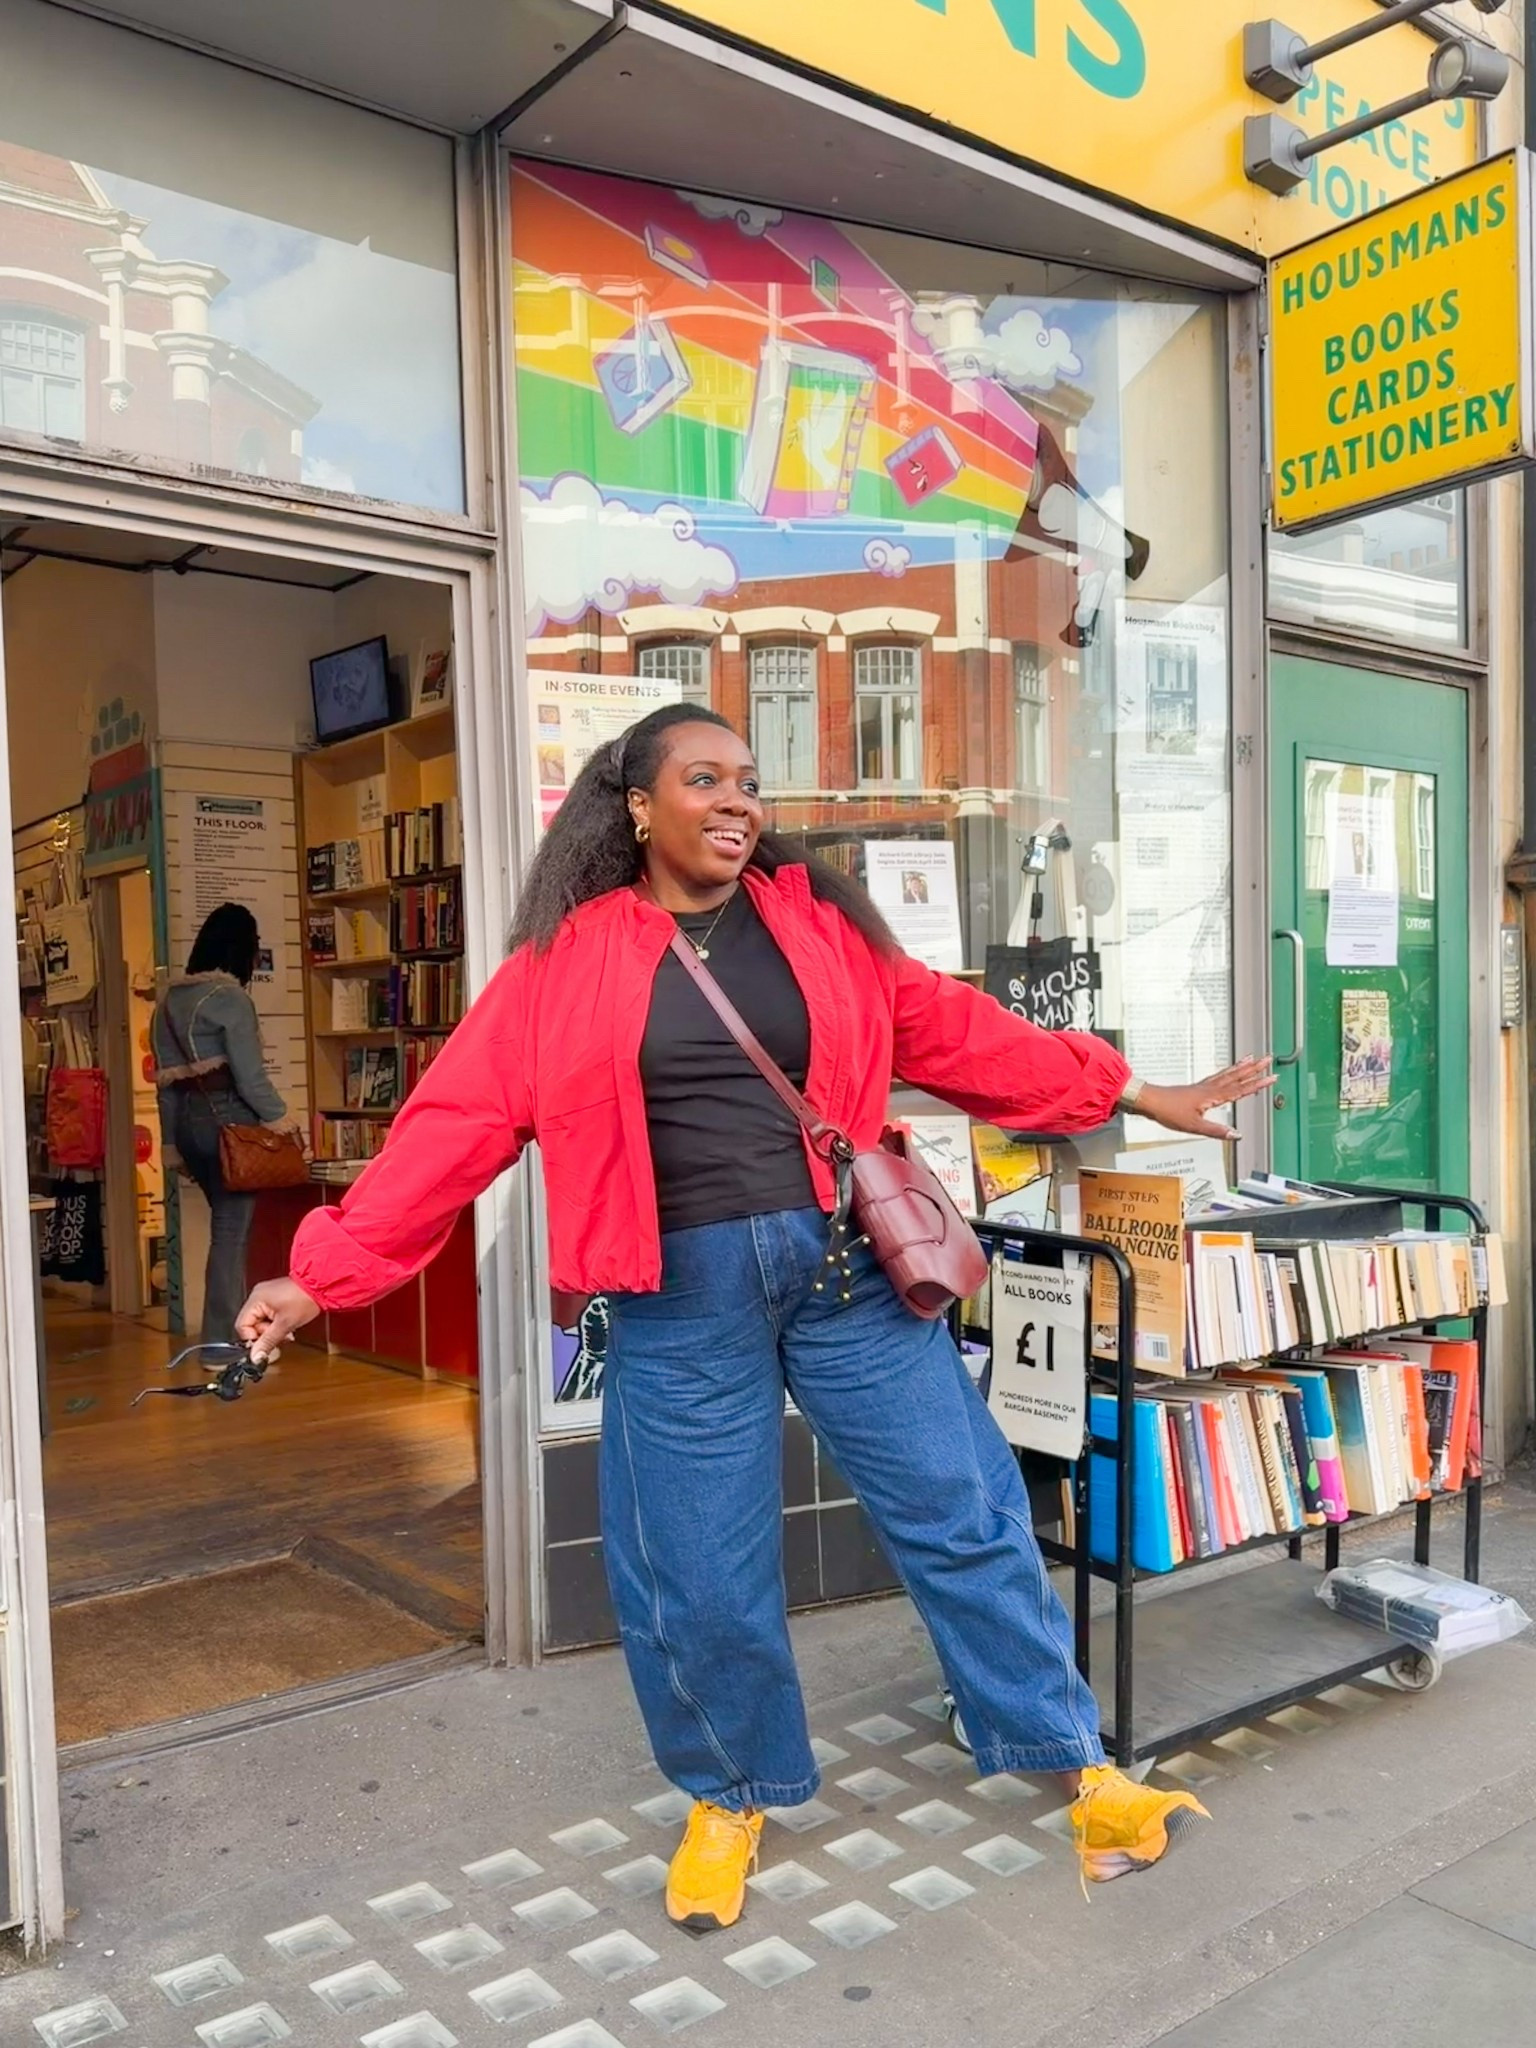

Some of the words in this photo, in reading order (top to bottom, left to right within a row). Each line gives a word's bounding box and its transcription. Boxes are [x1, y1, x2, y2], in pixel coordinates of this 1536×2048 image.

[1297, 73, 1431, 183] PEACE
[1282, 184, 1507, 315] HOUSMANS
[1324, 289, 1461, 375] BOOKS
[1327, 348, 1456, 426] CARDS
[1280, 382, 1516, 498] STATIONERY
[1124, 614, 1170, 629] Housmans
[544, 680, 607, 695] IN-STORE
[609, 684, 662, 699] EVENTS
[194, 816, 222, 828] THIS
[225, 818, 267, 831] FLOOR:
[1030, 957, 1090, 1010] HOUS
[1098, 1187, 1126, 1201] FIRST
[1128, 1190, 1160, 1204] STEPS
[1122, 1203, 1135, 1214] TO
[1084, 1213, 1179, 1241] BALLROOM
[1101, 1233, 1179, 1261] DANCING
[1001, 1269, 1043, 1282] COND-HAND
[1044, 1275, 1074, 1286] TROLEY
[1004, 1284, 1026, 1298] ALL
[1028, 1287, 1072, 1305] BOOKS
[1016, 1321, 1055, 1372] £1
[998, 1390, 1033, 1404] HUNDREDS
[1034, 1397, 1052, 1408] MORE
[1053, 1402, 1061, 1410] IN
[1061, 1404, 1076, 1413] OUR
[1003, 1401, 1033, 1415] BARGAIN
[1033, 1408, 1068, 1422] BASEMENT
